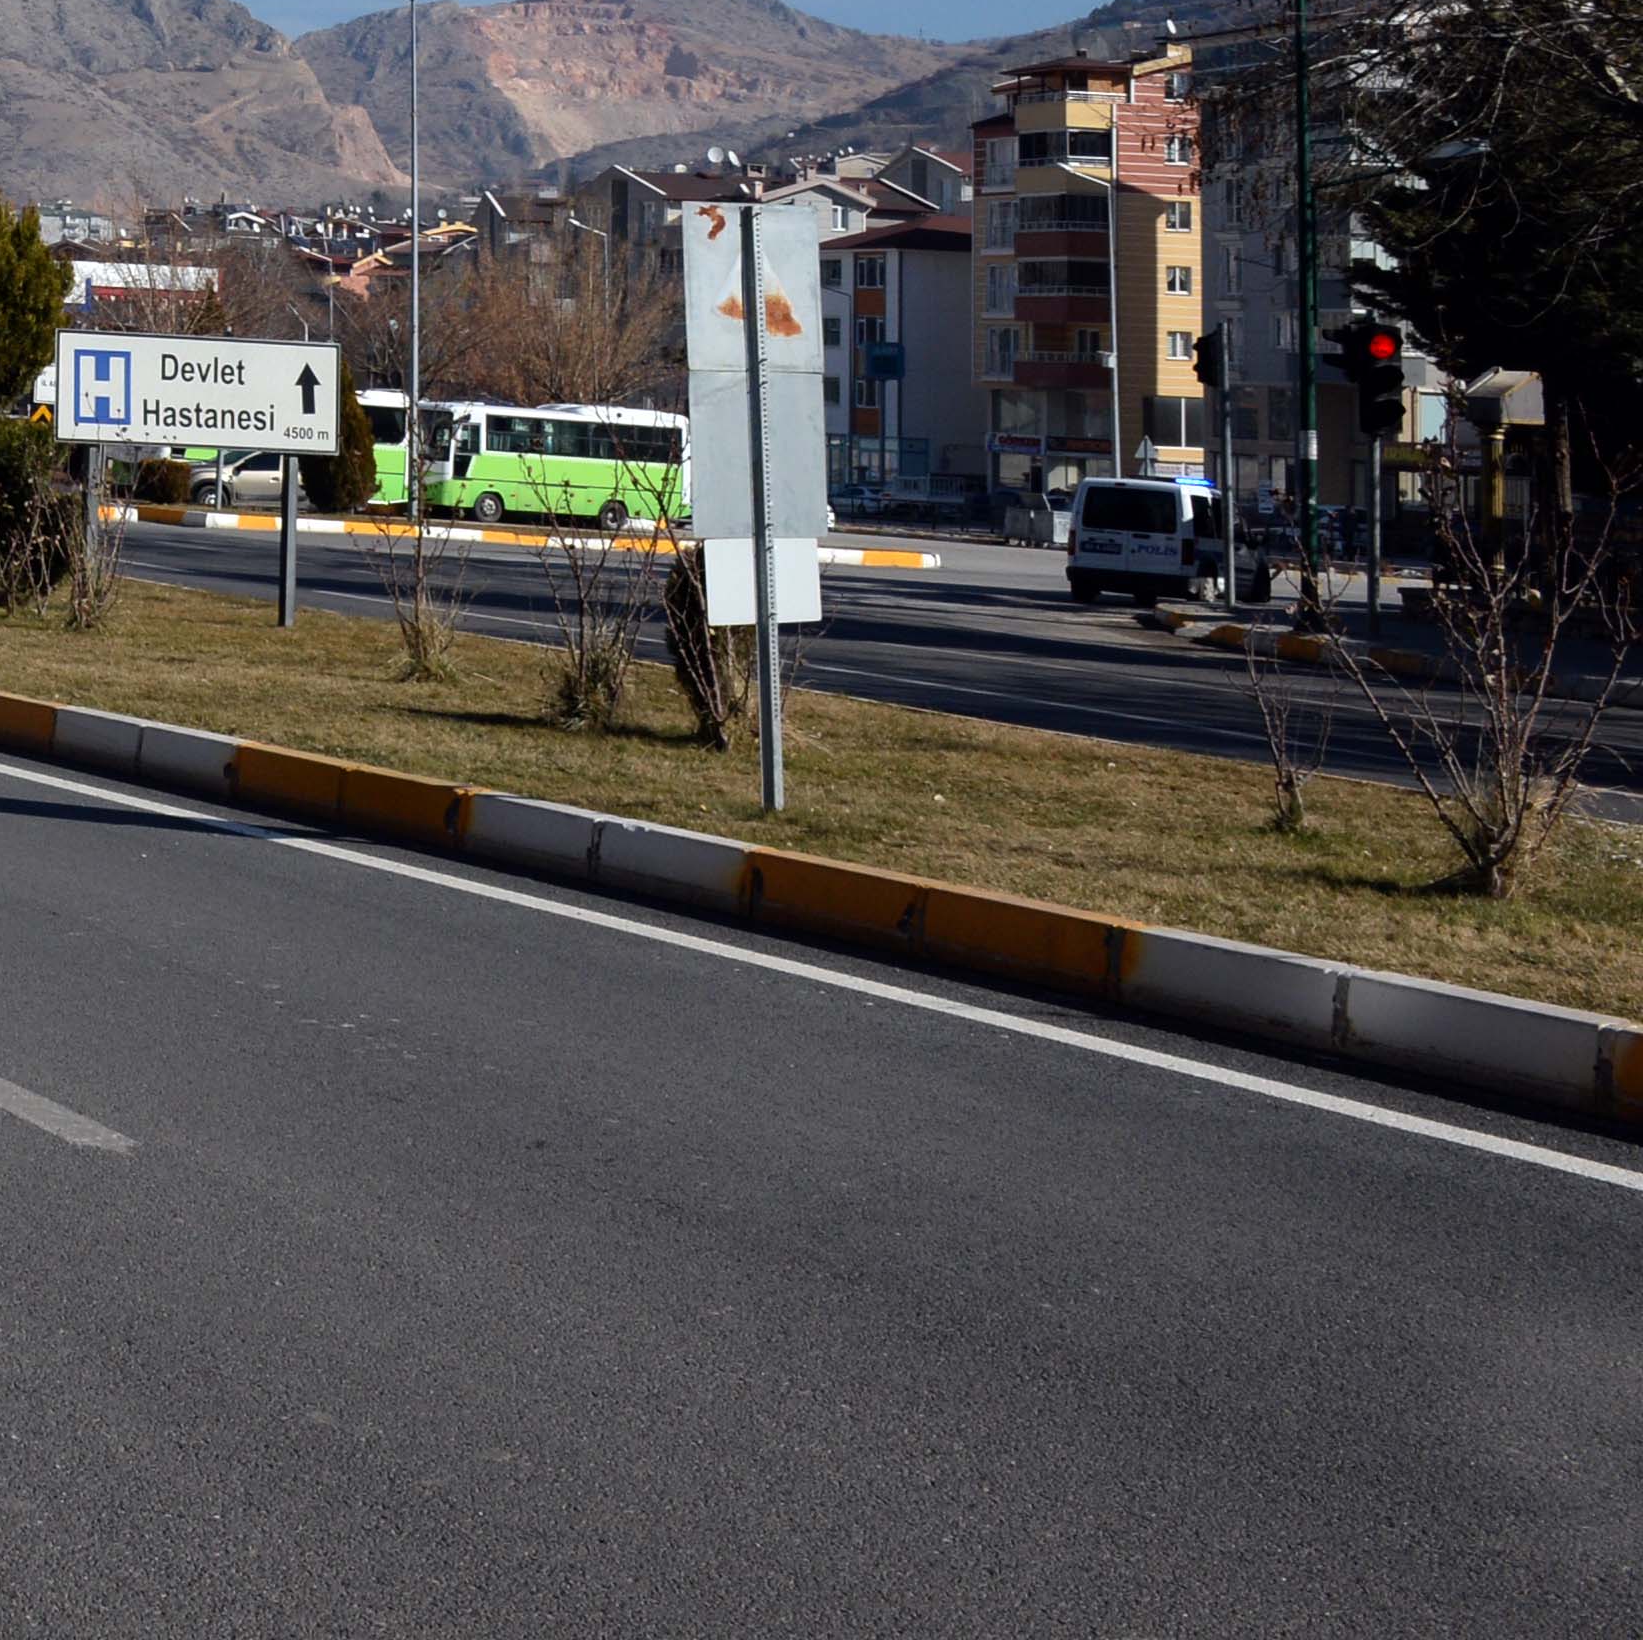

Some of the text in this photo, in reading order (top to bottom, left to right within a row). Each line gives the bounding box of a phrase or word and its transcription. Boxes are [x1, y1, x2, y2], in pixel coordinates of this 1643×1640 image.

[160, 353, 246, 386] Devlet
[142, 399, 275, 431] Hastanesi
[283, 426, 329, 441] 4500 m
